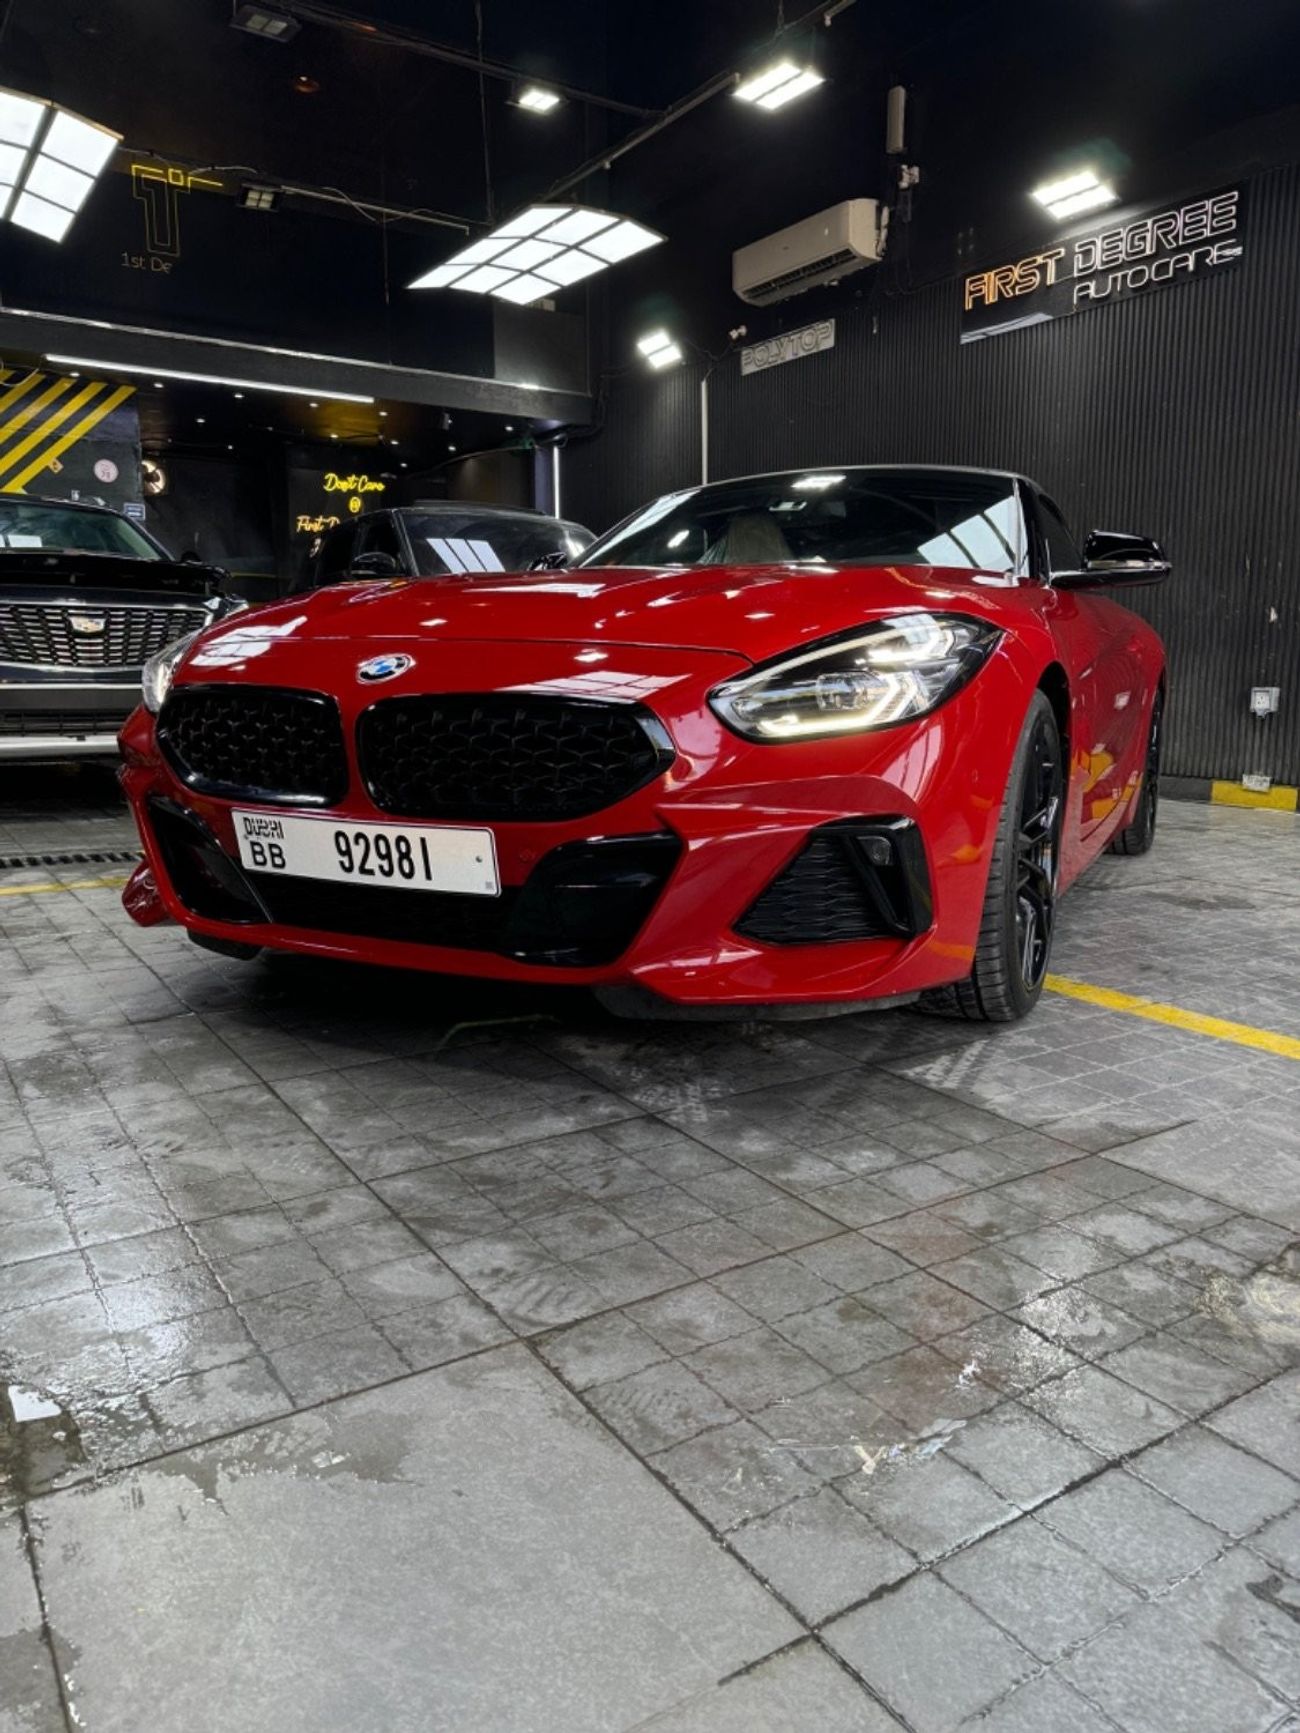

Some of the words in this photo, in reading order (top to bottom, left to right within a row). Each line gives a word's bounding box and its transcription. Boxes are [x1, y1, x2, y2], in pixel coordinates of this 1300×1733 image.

[121, 252, 146, 270] 1st
[965, 248, 1065, 311] FIRST
[1073, 190, 1239, 278] DEGREE
[742, 321, 833, 367] POLYTOP
[250, 840, 287, 870] BB
[333, 829, 434, 882] 92981
